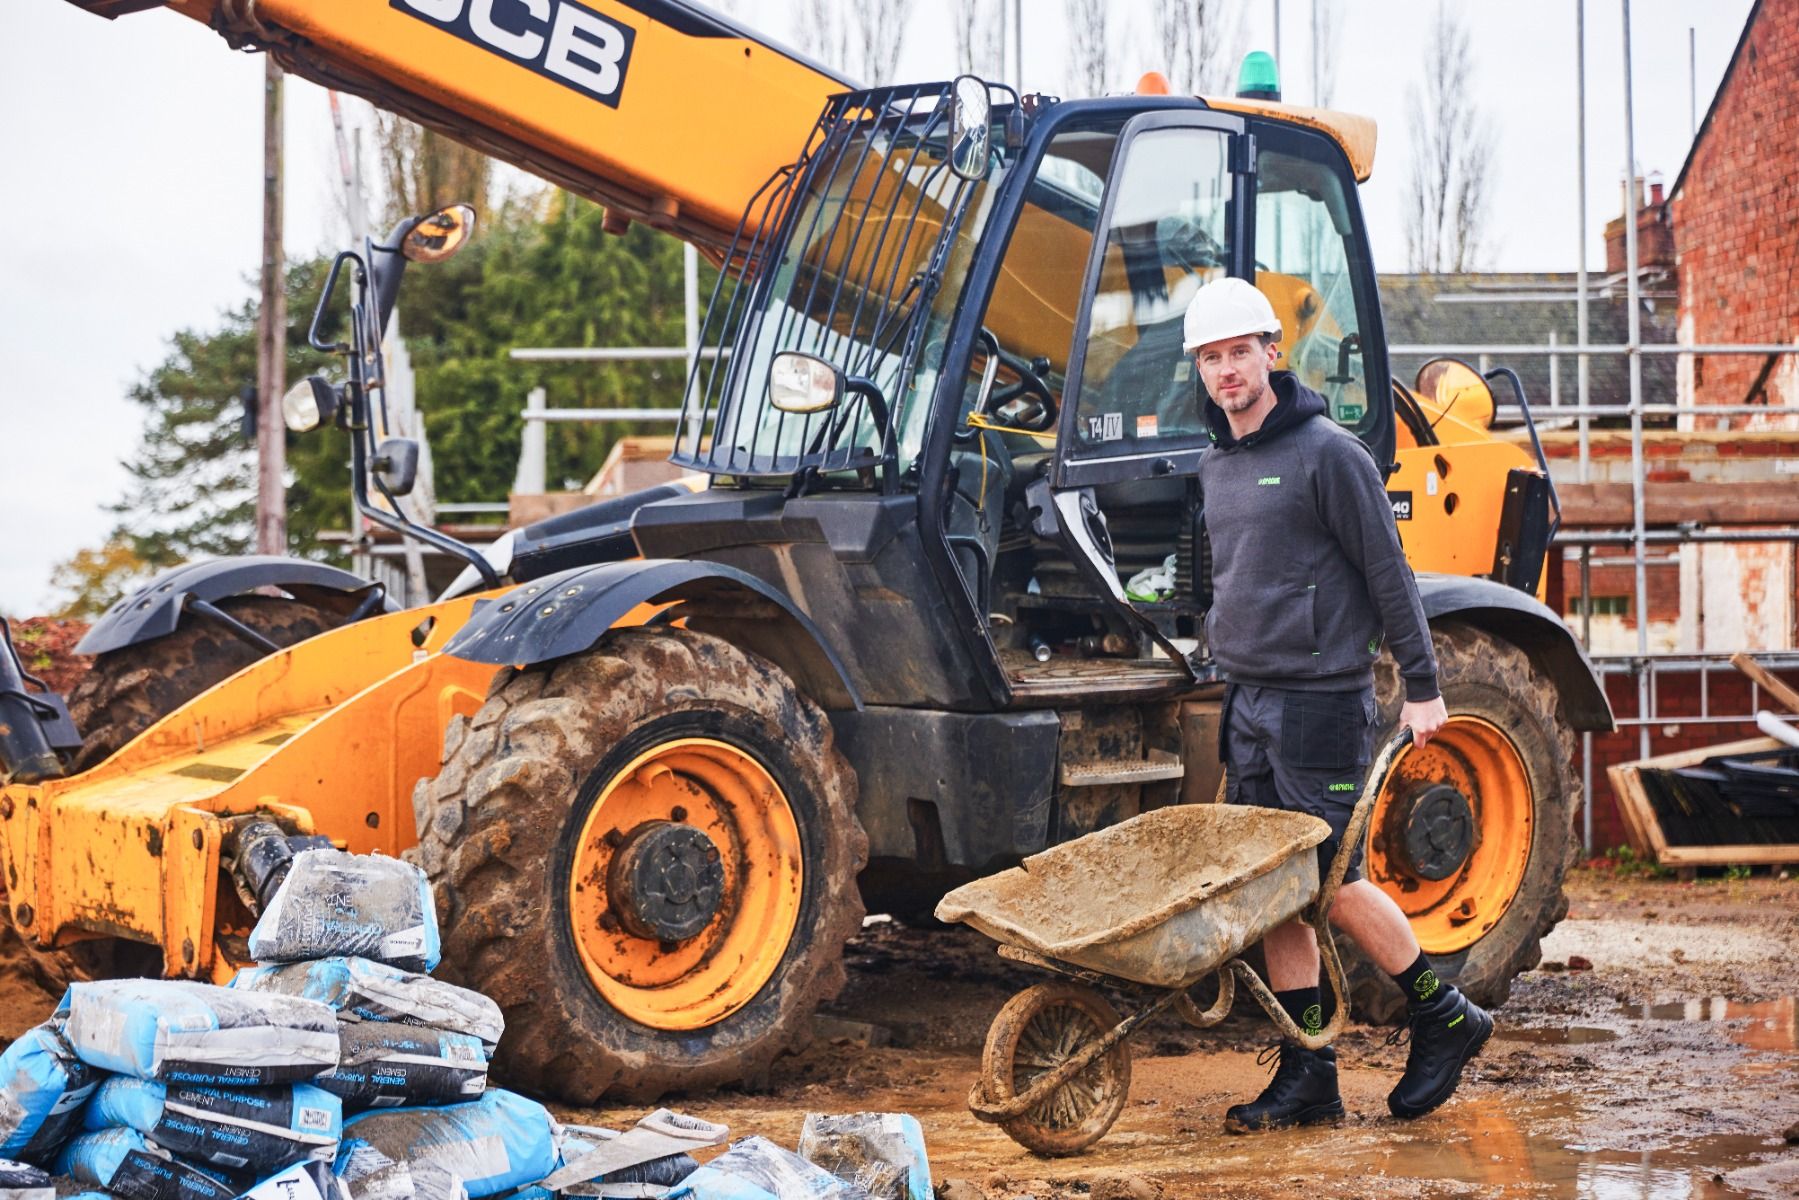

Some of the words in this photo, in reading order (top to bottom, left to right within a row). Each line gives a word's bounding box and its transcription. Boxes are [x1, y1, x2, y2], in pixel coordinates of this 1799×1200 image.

[1089, 417, 1103, 439] T4
[1106, 416, 1120, 437] IV
[172, 1071, 216, 1082] PURPOSE
[224, 1067, 261, 1078] CEMENT
[376, 1067, 407, 1077] CEMENT
[218, 1075, 260, 1086] GENERAL
[372, 1075, 406, 1086] GENERAL
[179, 1089, 216, 1107] CEMENT
[222, 1091, 265, 1109] PURPOSE
[165, 1118, 206, 1136] PURPOSE
[211, 1130, 249, 1146] GENERAL
[178, 1175, 216, 1198] GENERAL
